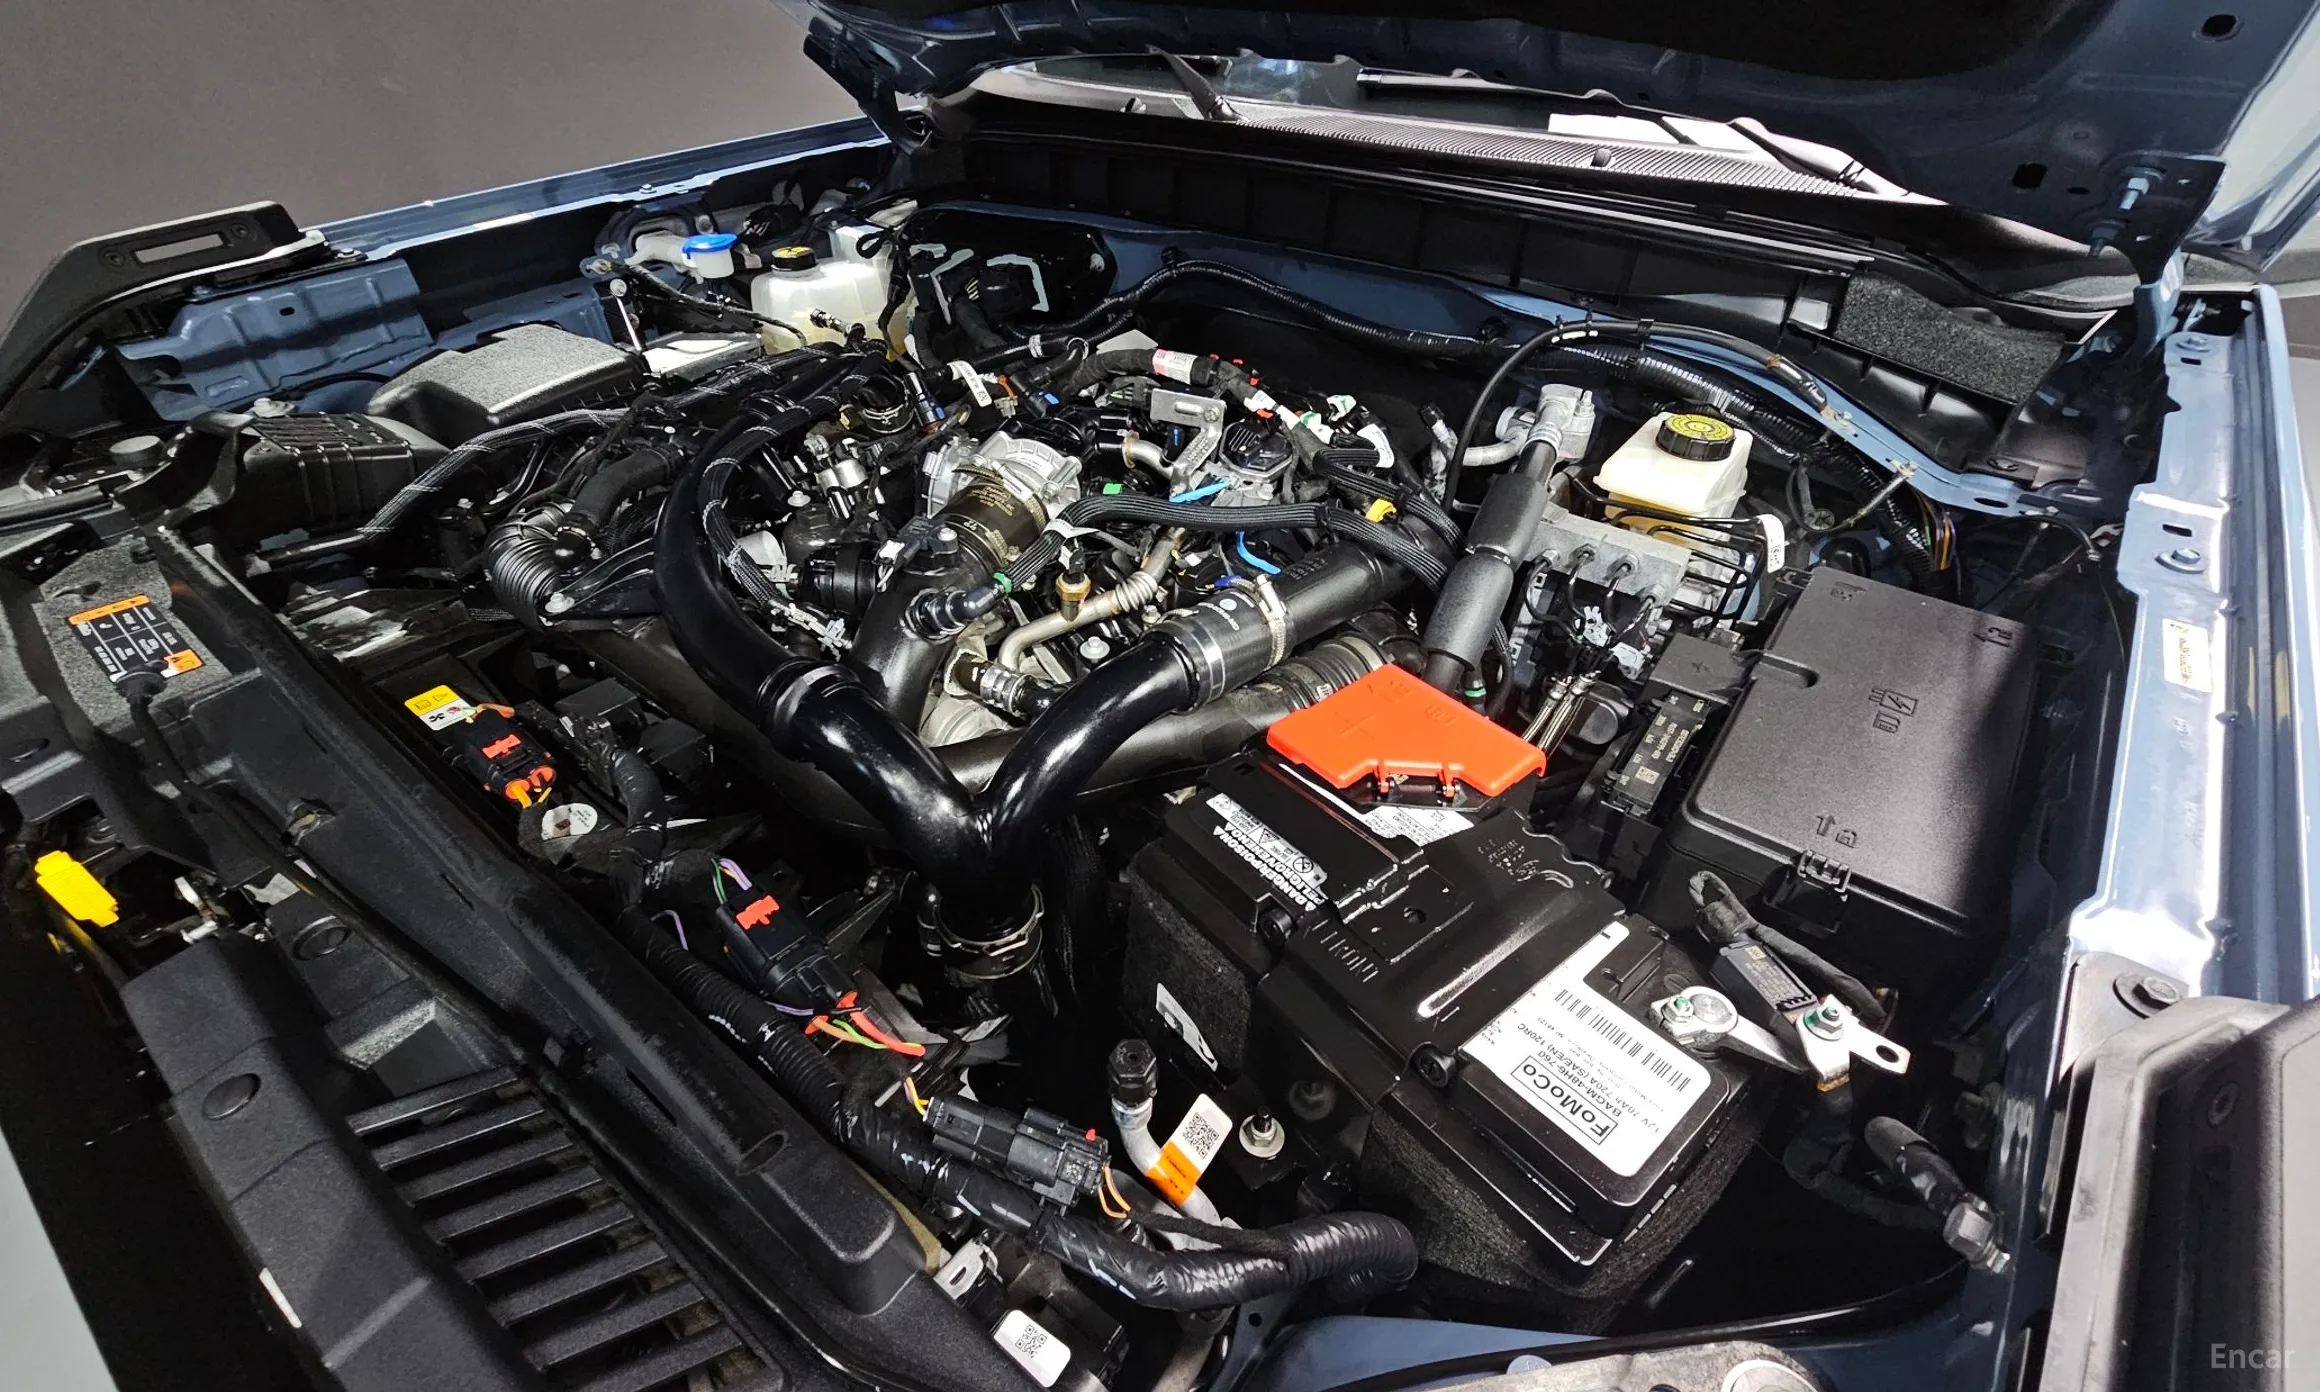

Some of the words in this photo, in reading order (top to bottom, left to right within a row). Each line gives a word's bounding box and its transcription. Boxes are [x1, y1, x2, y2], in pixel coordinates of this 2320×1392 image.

[1219, 832, 1308, 906] DANGER/POISON
[1230, 829, 1325, 906] PELIGRO/VENENO
[1516, 1022, 1546, 1046] 120RC
[1546, 1043, 1591, 1080] (SAE/EN)
[1522, 1063, 1611, 1138] FoMoCo
[1537, 1050, 1623, 1118] BAGM-48H6-760
[1589, 1075, 1614, 1097] 720A
